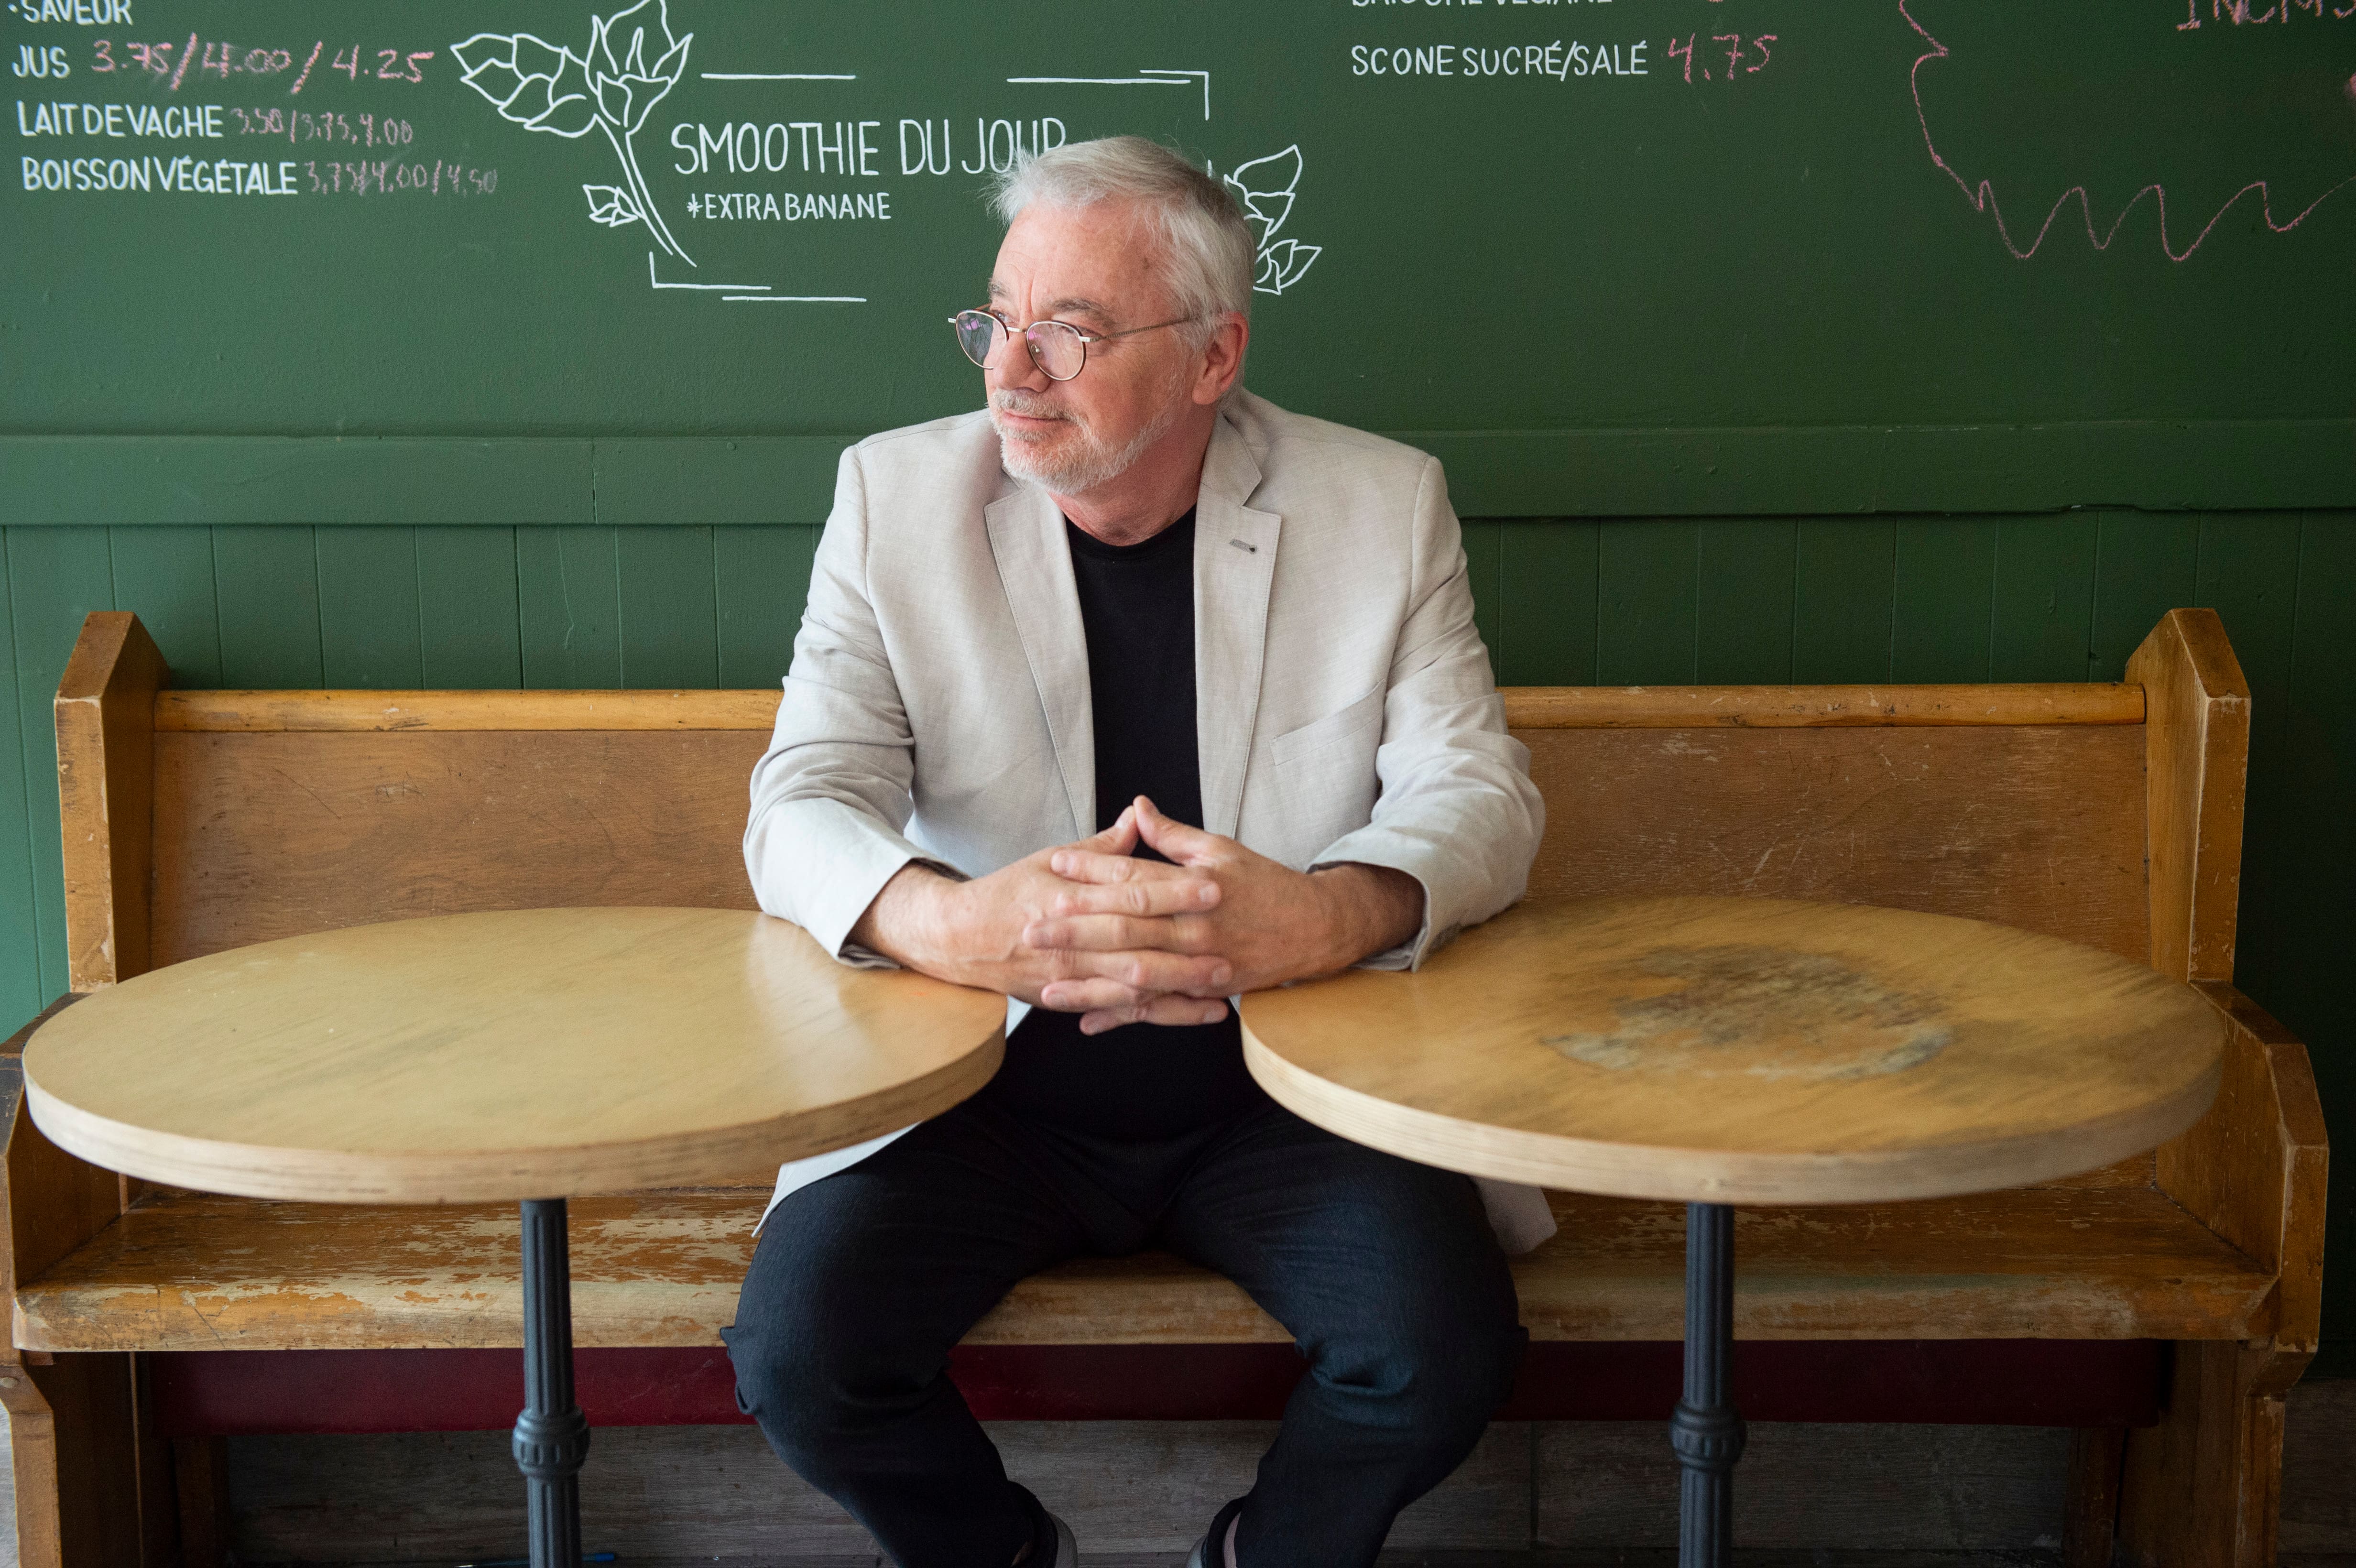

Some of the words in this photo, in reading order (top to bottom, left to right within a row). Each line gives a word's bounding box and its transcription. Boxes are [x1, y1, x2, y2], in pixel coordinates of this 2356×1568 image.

[12, 45, 70, 79] JUS
[1351, 45, 1456, 76] SCONE
[17, 100, 78, 137] LAIT
[82, 103, 126, 137] DE
[125, 104, 223, 139] VACHE
[671, 121, 881, 176] SMOOTHIE
[899, 119, 950, 175] DU
[22, 156, 151, 192] BOISSON
[153, 154, 298, 195] VÉGÉTALE
[785, 192, 892, 221] BANANE
